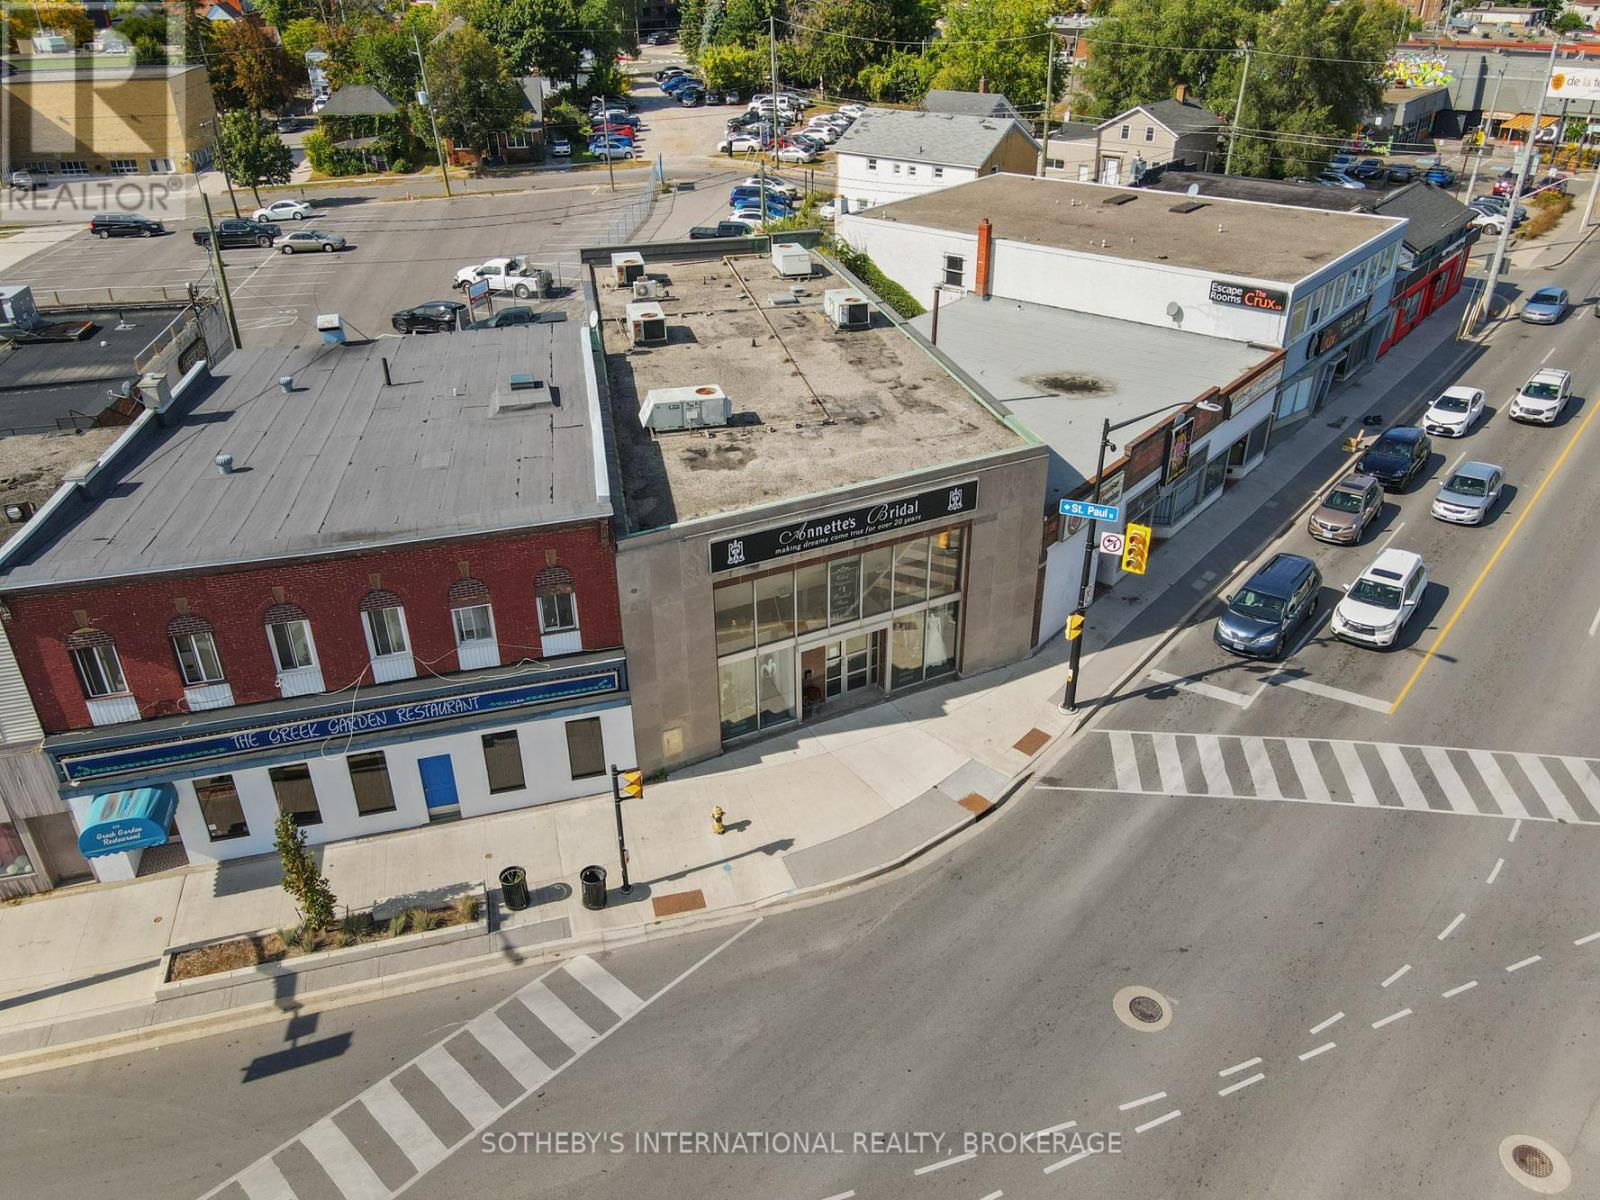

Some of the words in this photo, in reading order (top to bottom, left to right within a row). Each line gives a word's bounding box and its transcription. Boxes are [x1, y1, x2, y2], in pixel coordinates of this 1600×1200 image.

[1566, 75, 1580, 87] de
[1211, 283, 1243, 295] Escape
[1255, 289, 1267, 298] The
[1210, 291, 1242, 304] Rooms
[1072, 504, 1084, 514] St.
[1087, 506, 1108, 518] Paul
[779, 517, 857, 545] Annette's
[867, 501, 919, 523] Bridal
[774, 543, 802, 555] making
[803, 537, 829, 548] dreams
[830, 532, 849, 542] come
[850, 528, 864, 537] true
[865, 525, 876, 534] for
[877, 521, 893, 530] over
[893, 518, 903, 526] 20
[904, 514, 922, 525] years
[230, 735, 260, 750] THE
[269, 723, 321, 745] GREEK
[328, 711, 387, 735] GARDEN
[399, 697, 480, 721] RESTAURANT
[97, 831, 116, 840] Greek
[118, 826, 142, 836] Garden
[104, 833, 140, 845] Restaurant
